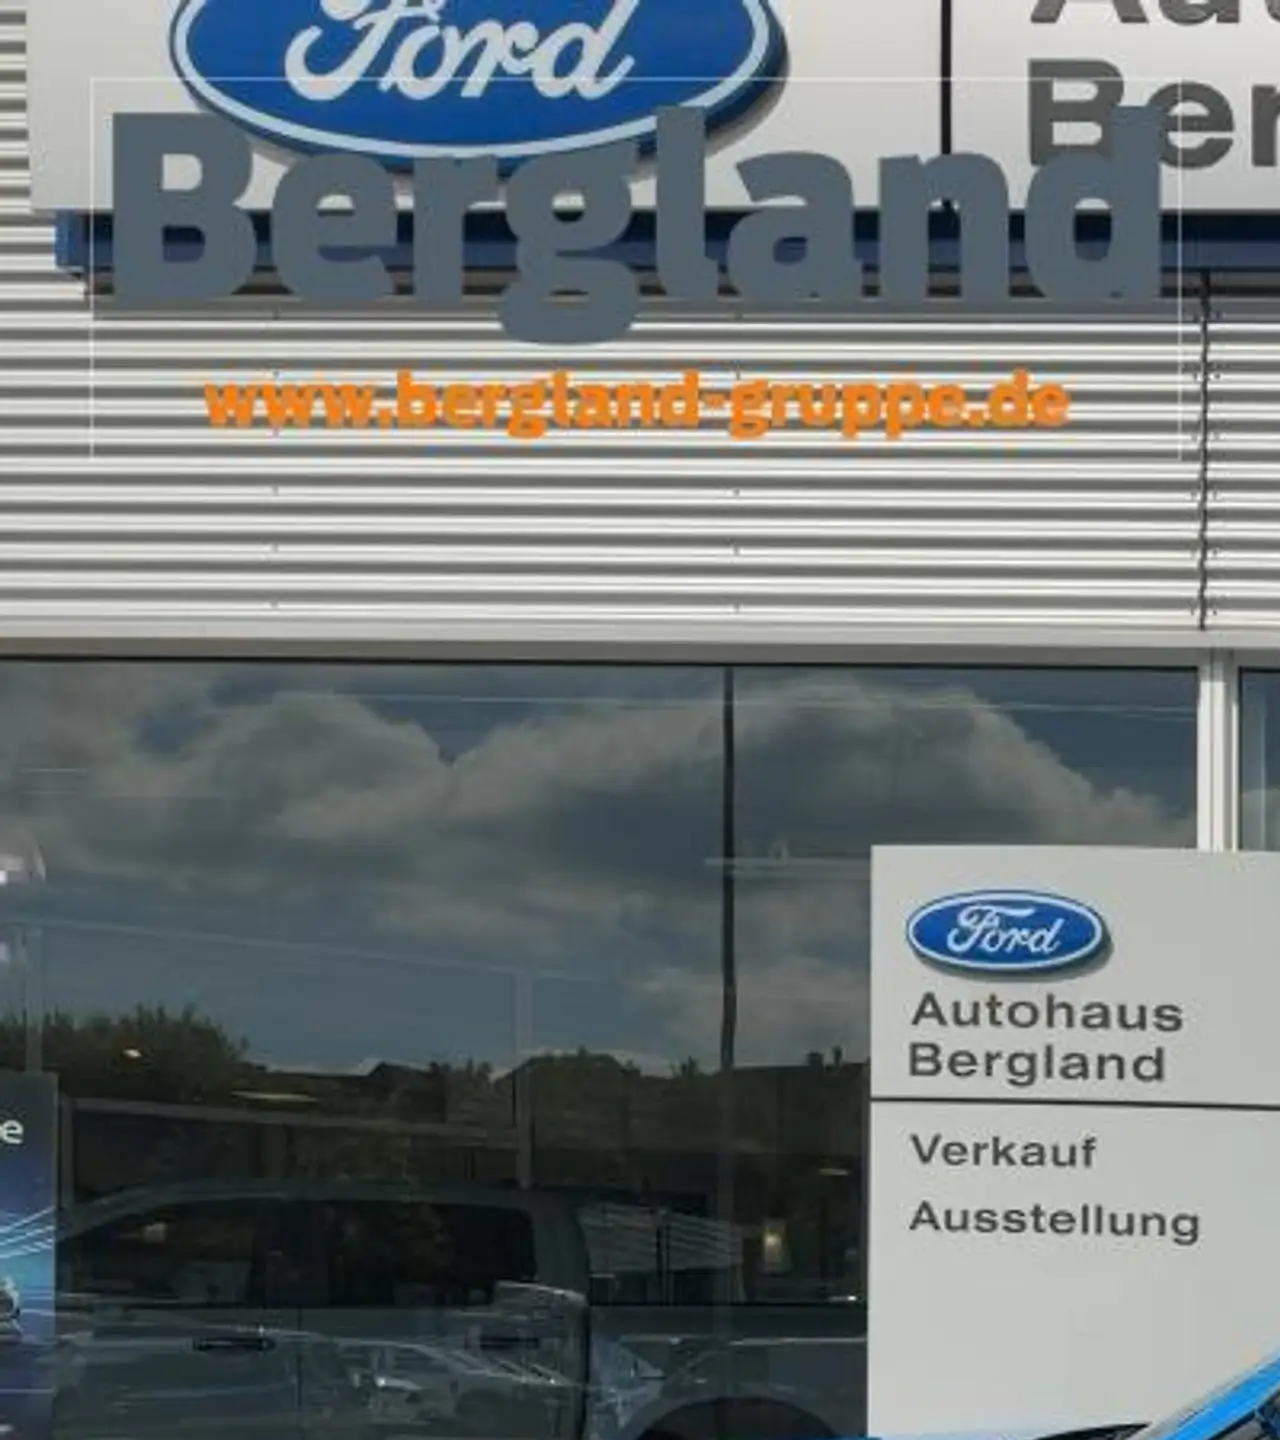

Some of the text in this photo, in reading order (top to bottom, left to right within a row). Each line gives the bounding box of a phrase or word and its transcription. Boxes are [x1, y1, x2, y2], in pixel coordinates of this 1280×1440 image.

[284, 0, 636, 101] Ford
[946, 903, 1066, 954] Ford
[911, 993, 1184, 1032] Autohaus
[909, 1042, 1166, 1086] Bergland
[911, 1134, 1097, 1168] Verkauf
[909, 1201, 1201, 1246] Ausstellung
